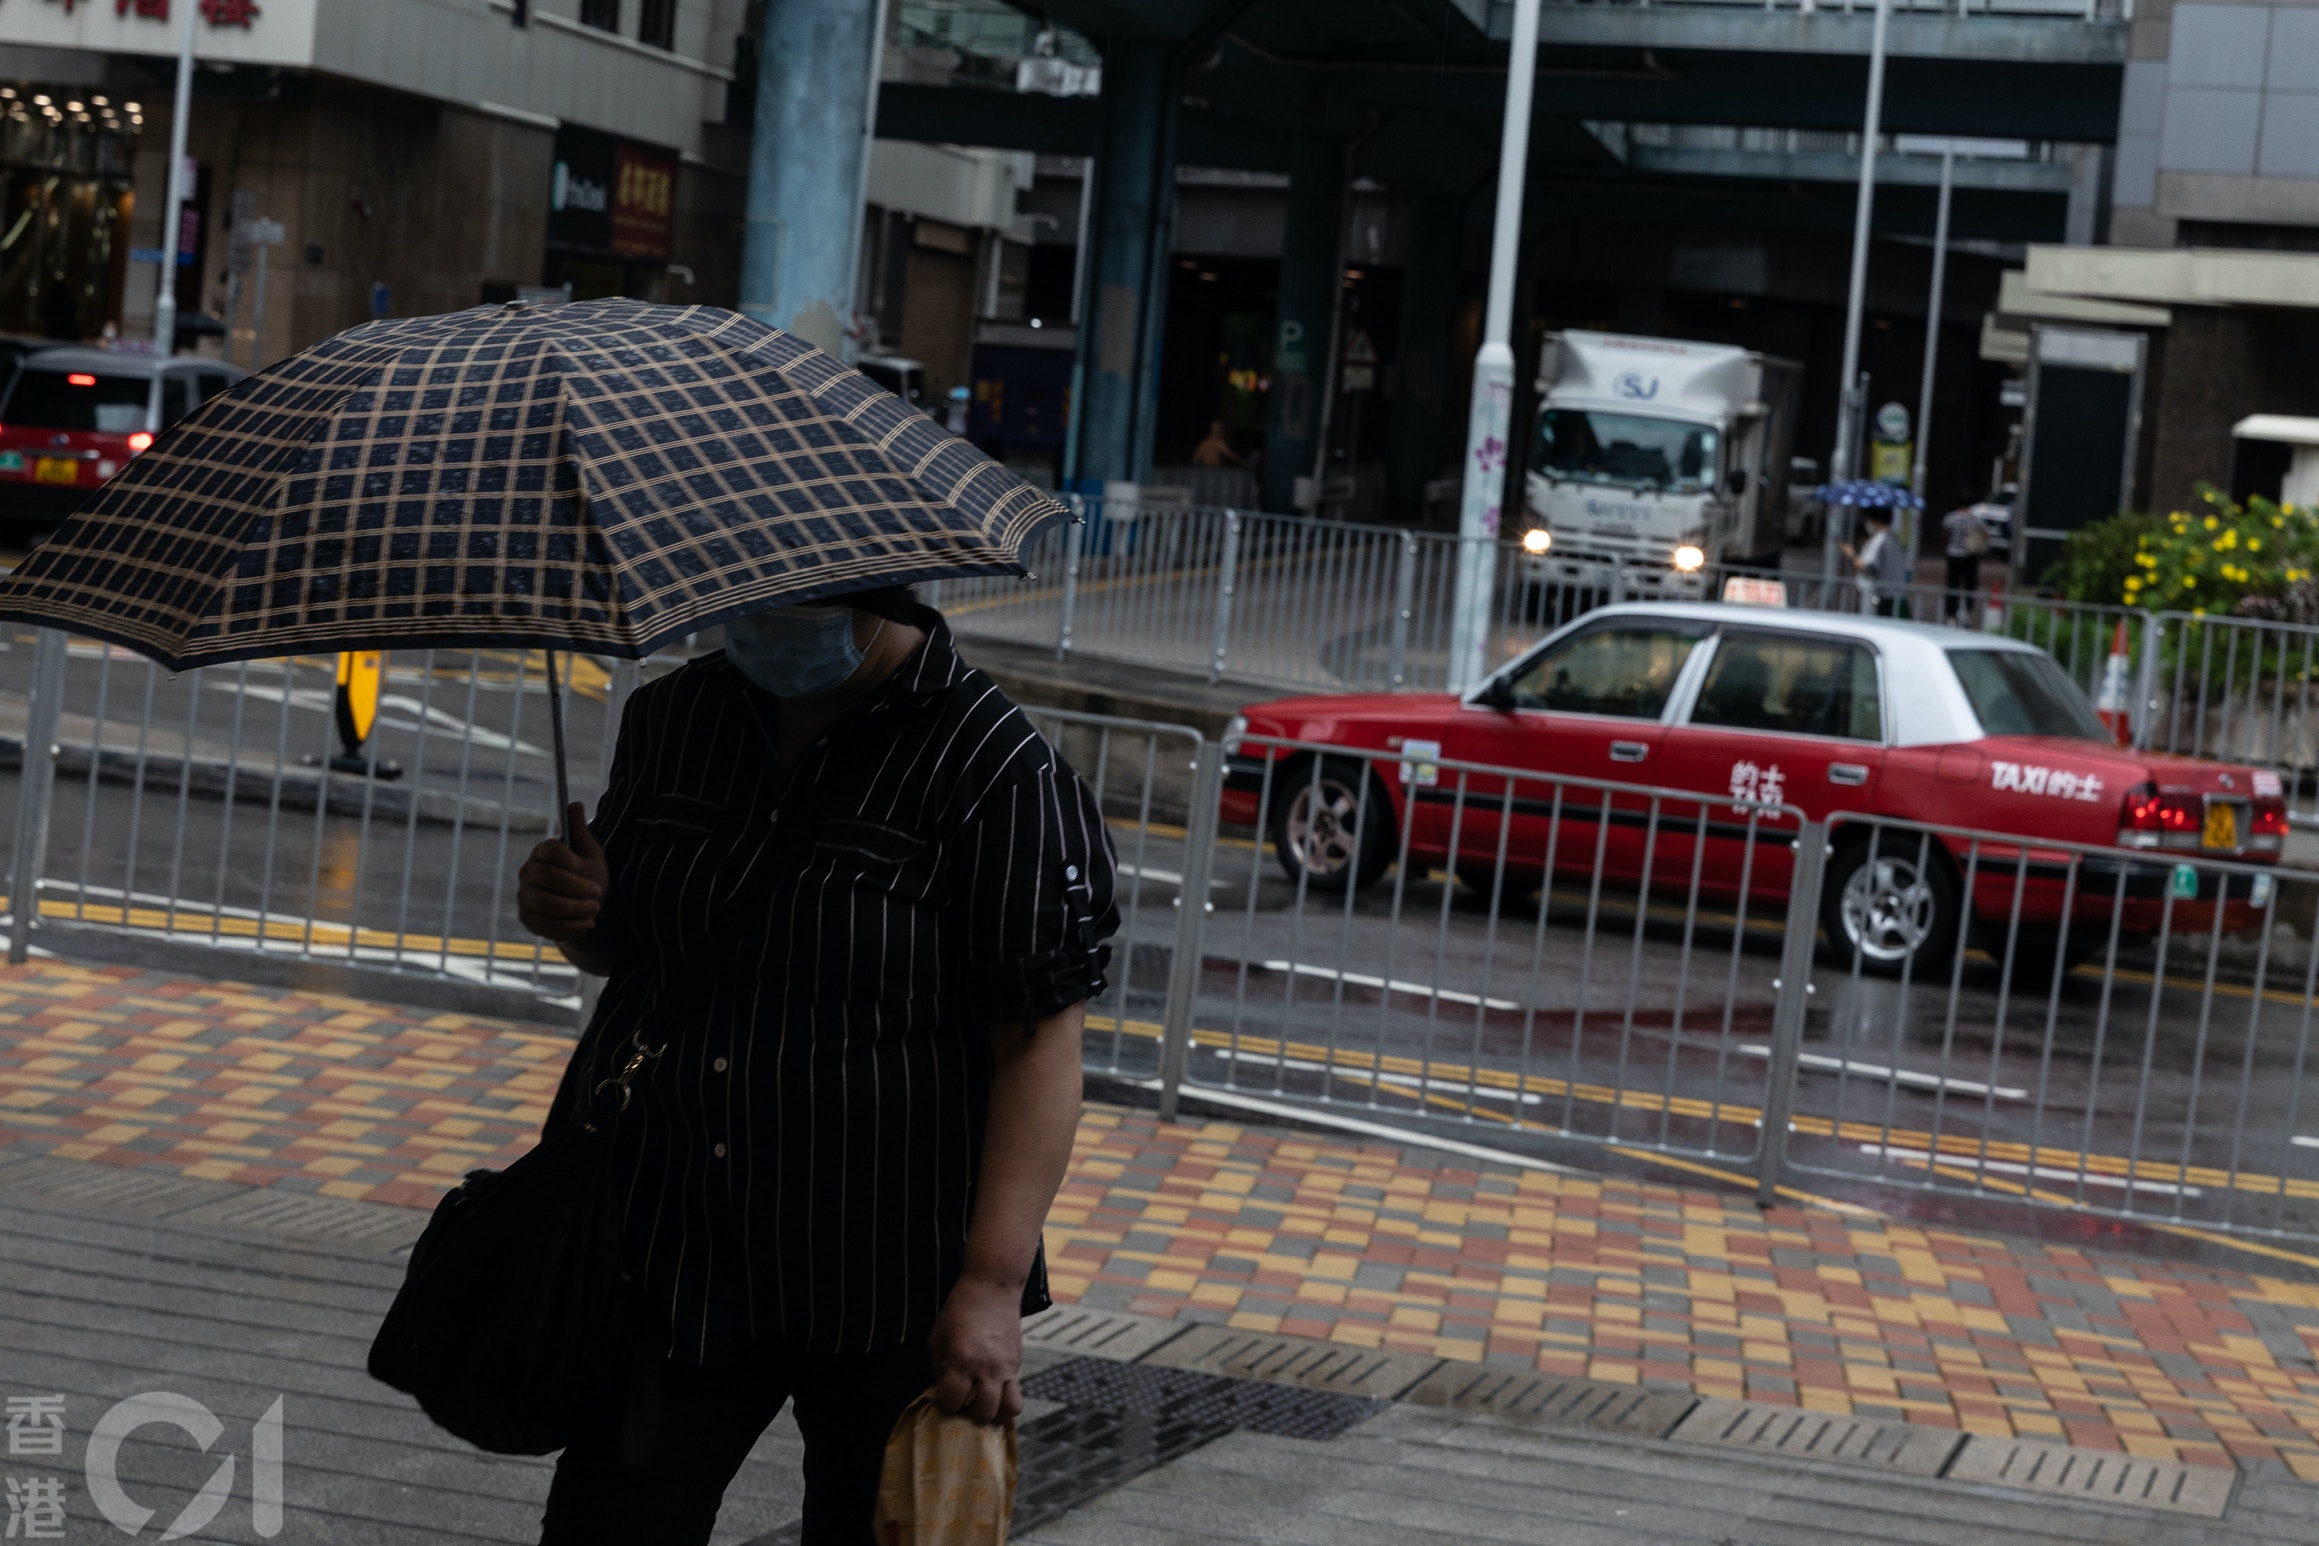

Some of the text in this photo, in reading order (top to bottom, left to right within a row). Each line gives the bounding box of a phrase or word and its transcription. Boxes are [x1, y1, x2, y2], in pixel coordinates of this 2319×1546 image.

[1730, 759, 1786, 791] 的士
[1991, 761, 2104, 802] TAXI 的士
